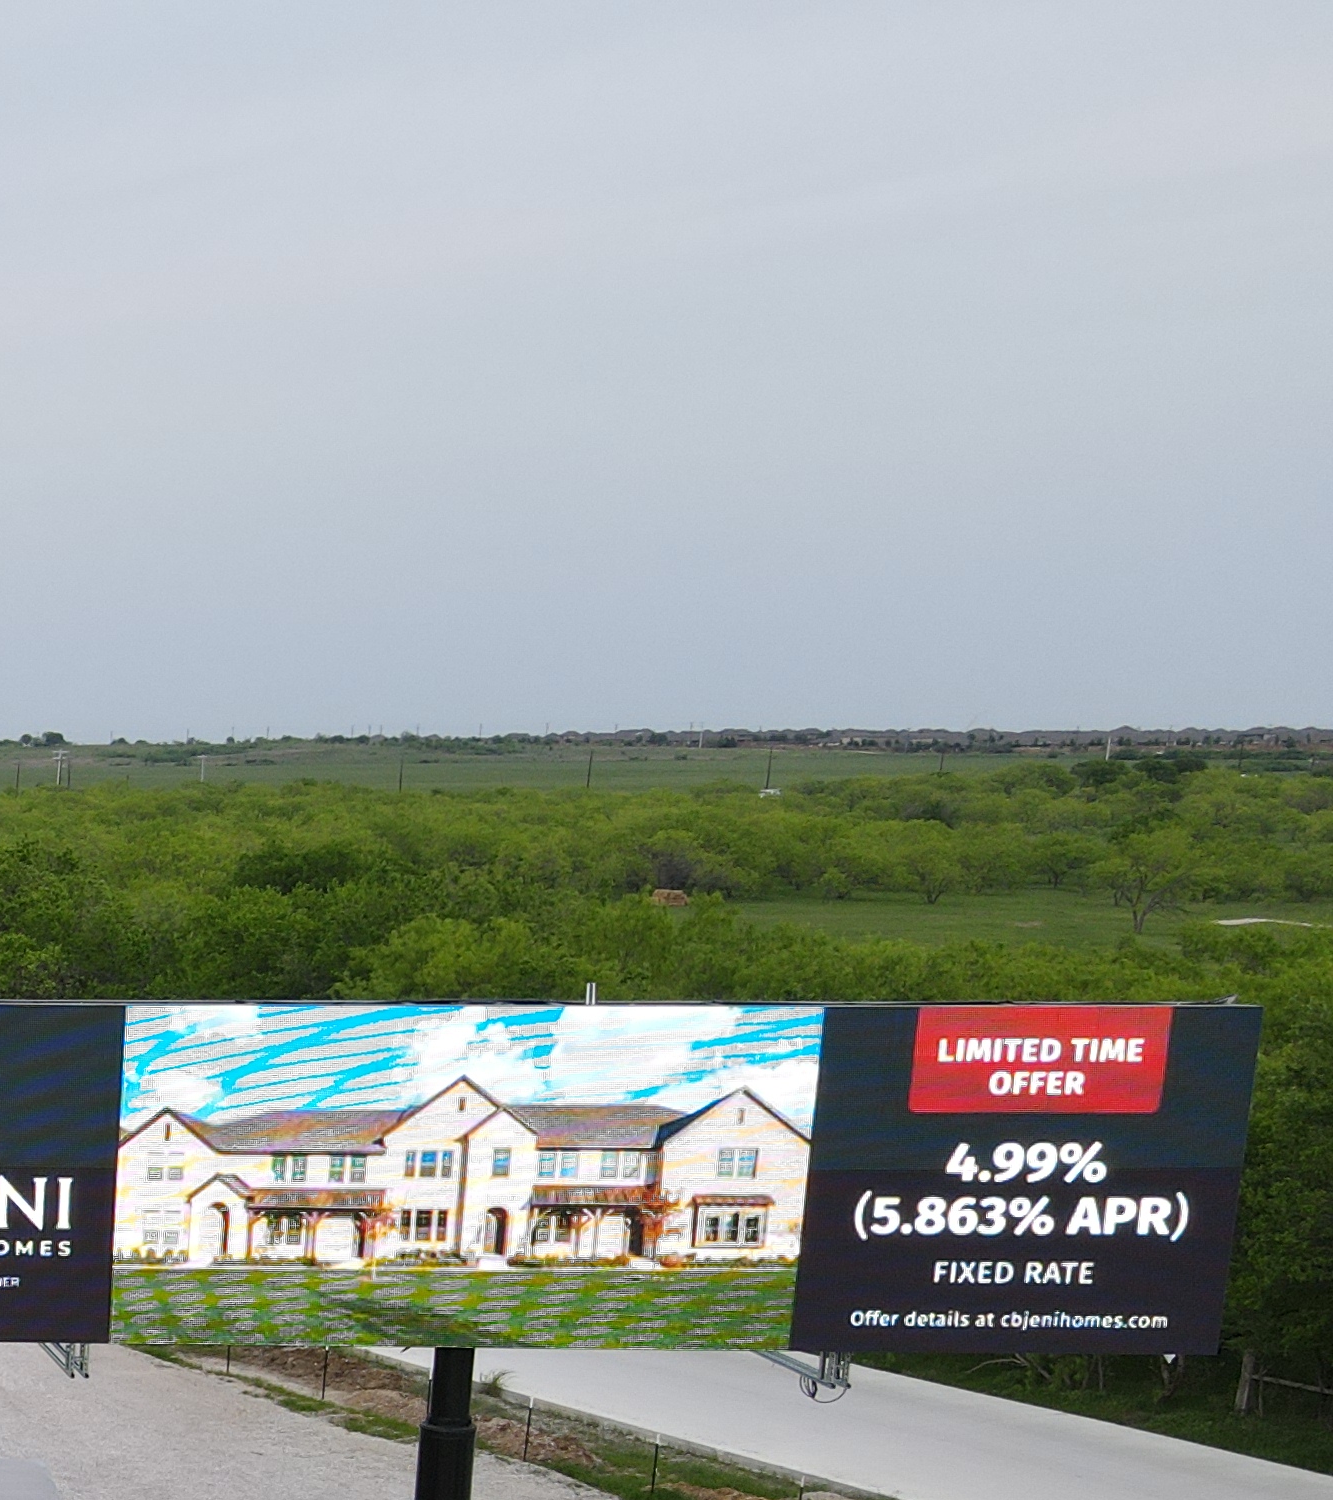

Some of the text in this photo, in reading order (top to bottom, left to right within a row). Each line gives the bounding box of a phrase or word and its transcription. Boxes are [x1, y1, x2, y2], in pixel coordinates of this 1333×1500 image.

[937, 1037, 1145, 1063] LIMITED TIME
[988, 1070, 1086, 1096] OFFER
[945, 1141, 1108, 1184] 4.99%
[853, 1190, 1189, 1242] (5.863% APR)
[933, 1261, 1095, 1285] FIXED RATE
[849, 1309, 1168, 1331] Offer details at cbjenihomes.com
